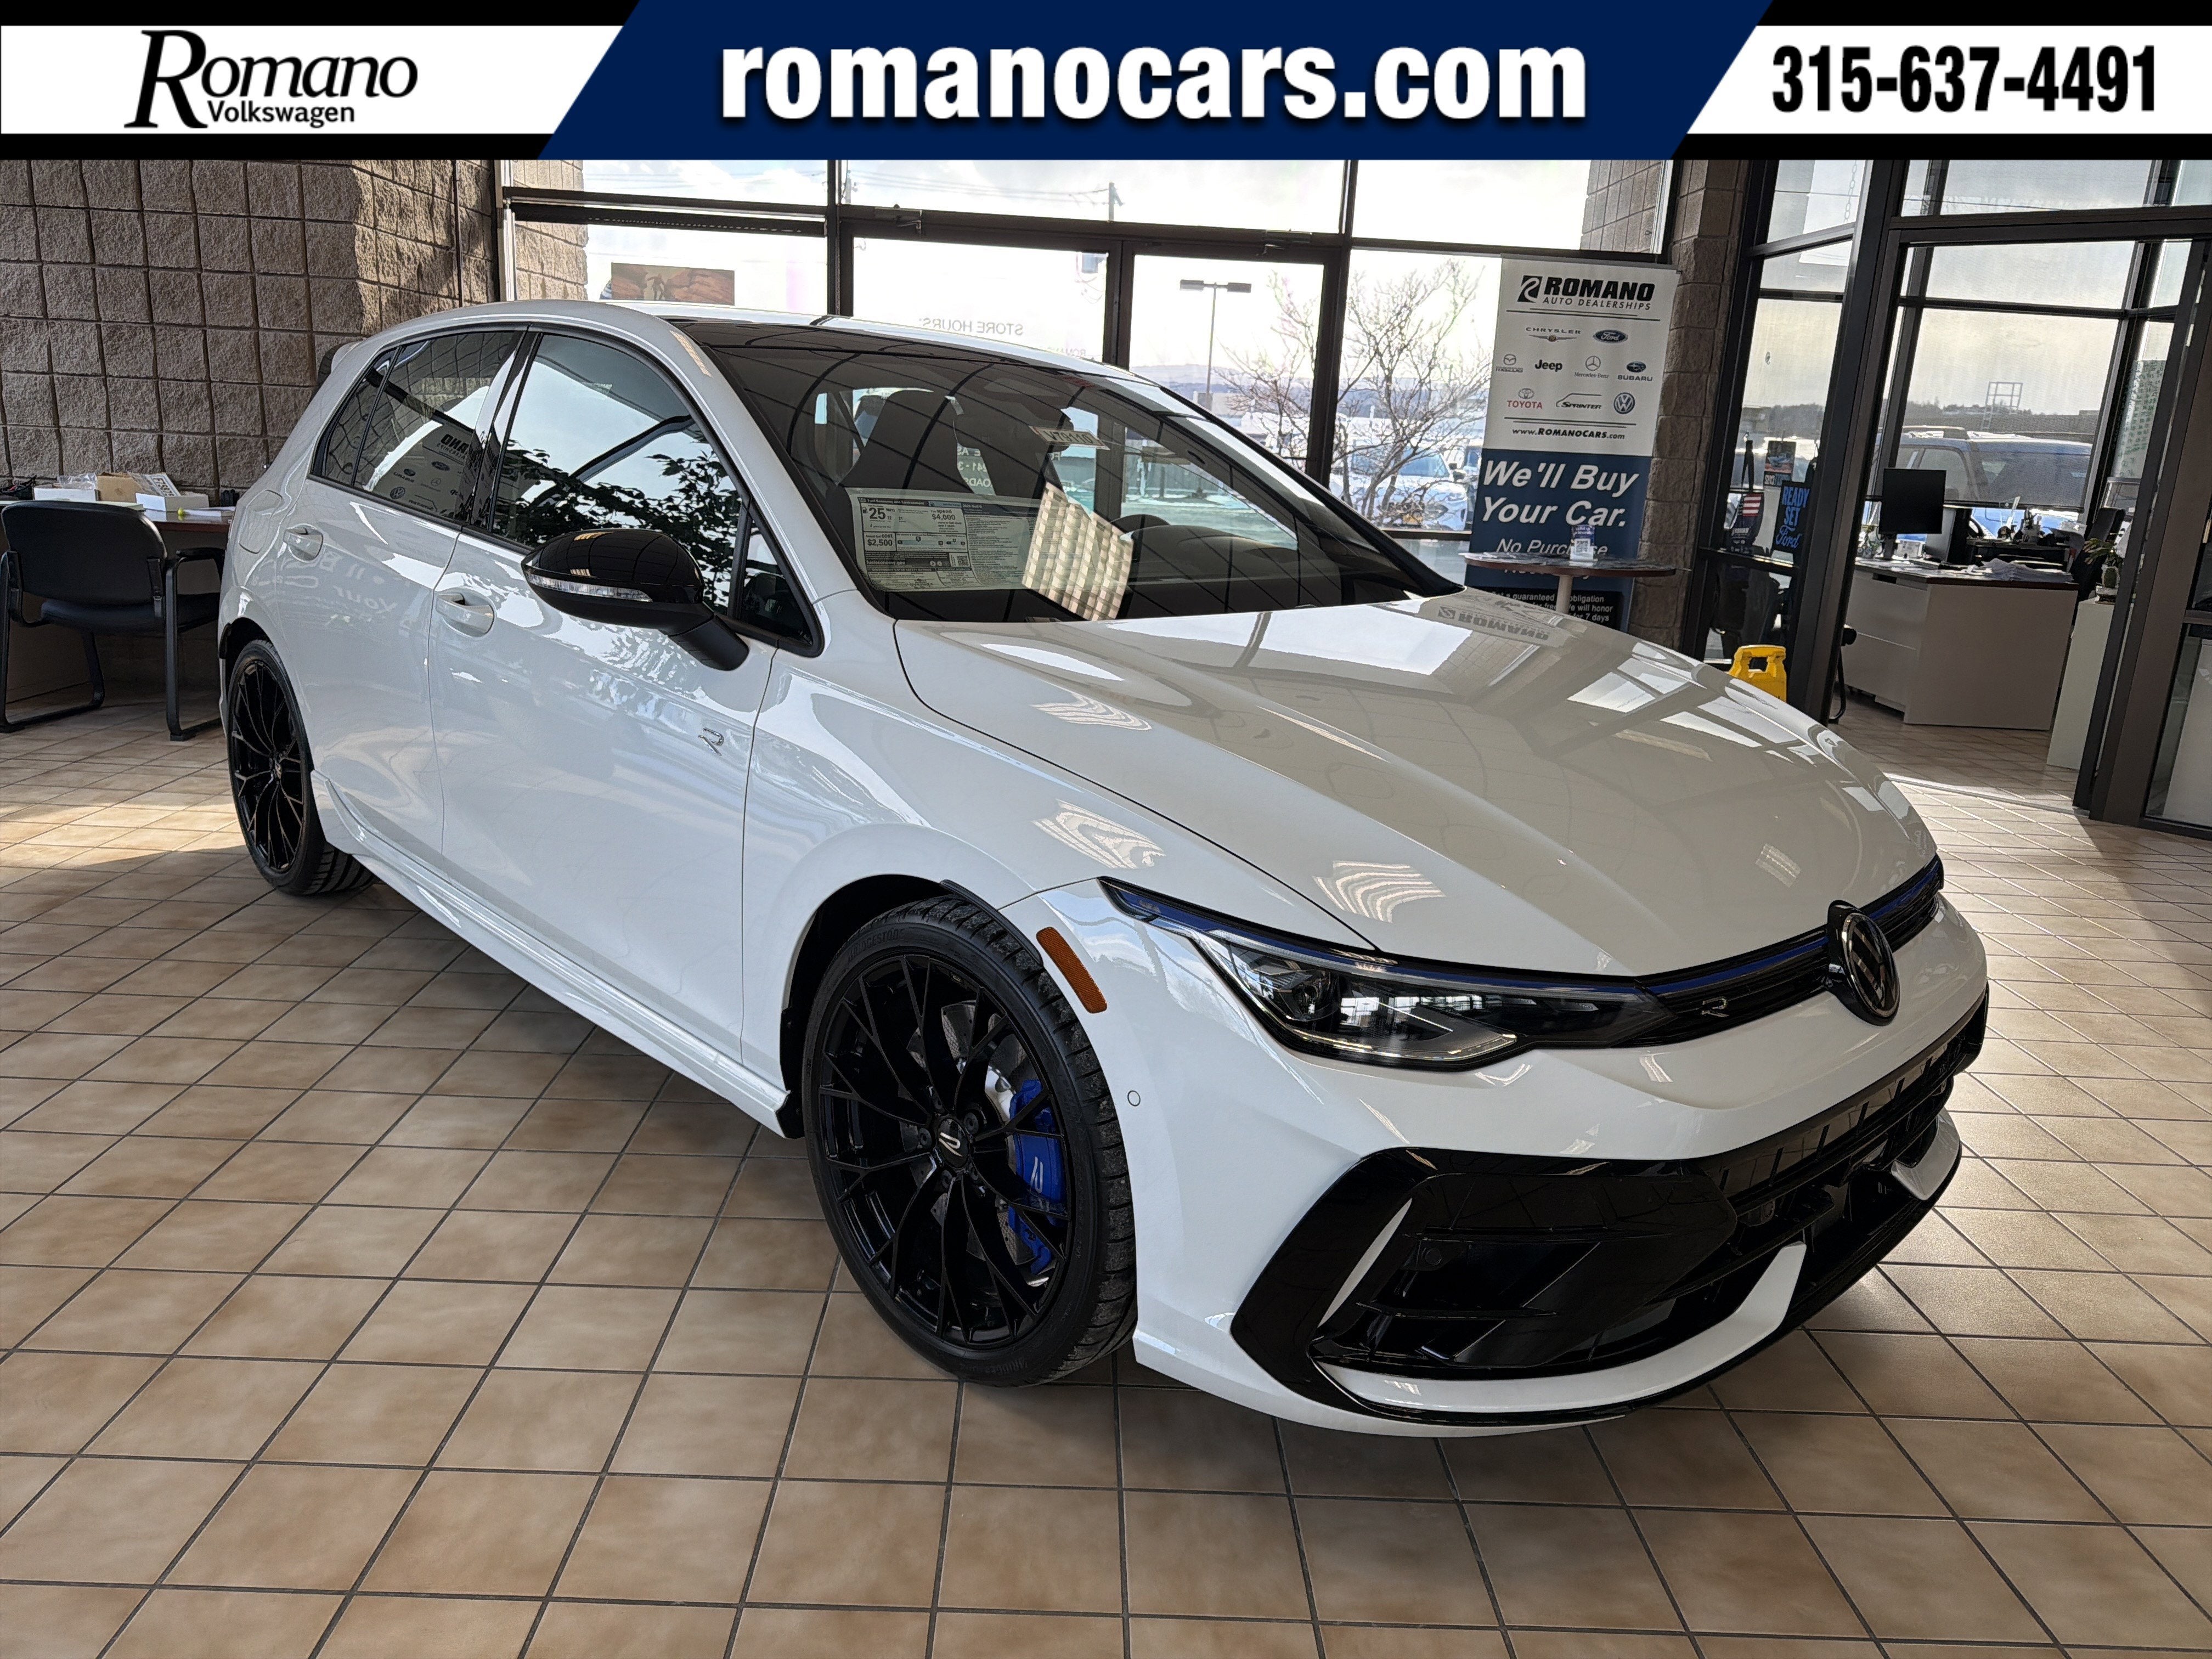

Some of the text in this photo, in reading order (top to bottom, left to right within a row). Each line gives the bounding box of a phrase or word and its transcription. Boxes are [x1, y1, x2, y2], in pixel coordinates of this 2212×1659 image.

[1544, 276, 1655, 301] ROMANO
[1543, 297, 1651, 311] AUTO DEALERSHIPS
[1600, 331, 1620, 341] Ford
[1535, 359, 1563, 372] Jeep
[1507, 400, 1543, 409] TOYOTA
[1483, 460, 1639, 498] We'll Buy
[1781, 486, 1810, 508] READY
[869, 507, 886, 520] 25
[1482, 496, 1626, 527] Your Car.
[1784, 506, 1801, 526] SET
[1775, 525, 1803, 549] Ford
[1496, 538, 1522, 553] No
[1513, 592, 1555, 602] guaranteed
[1592, 613, 1610, 622] days
